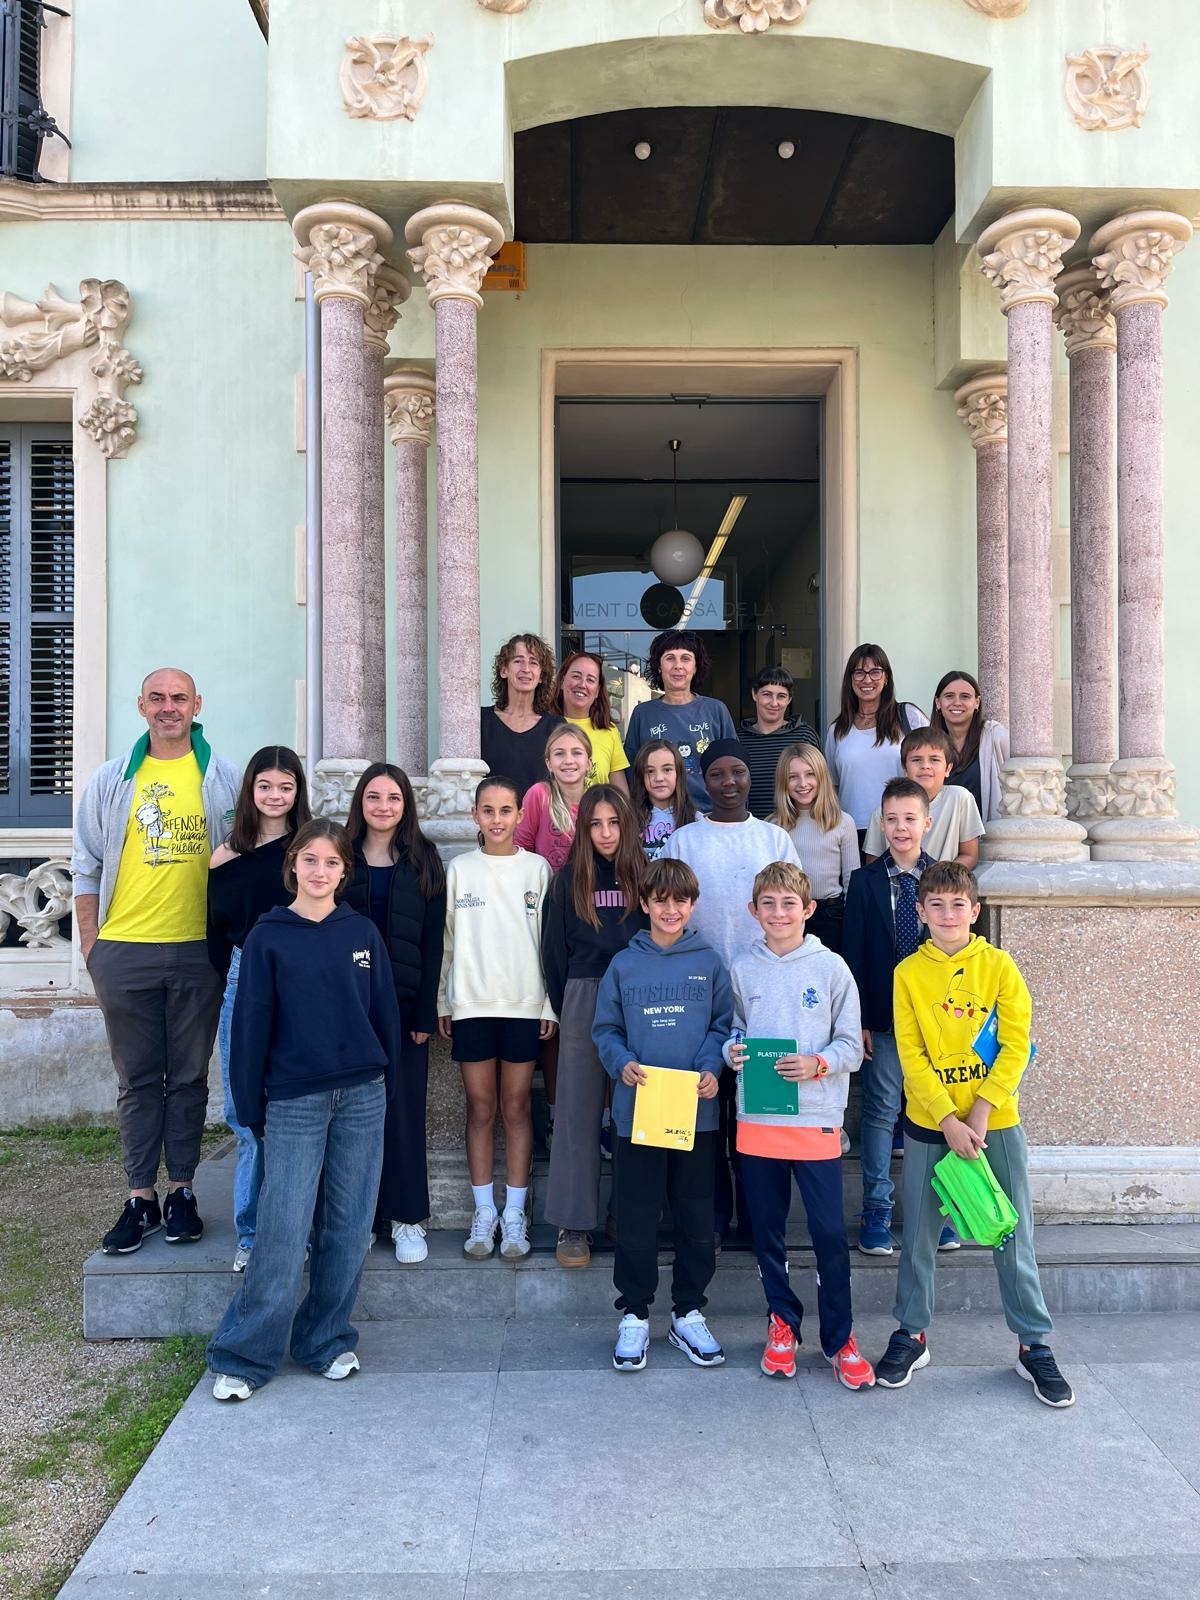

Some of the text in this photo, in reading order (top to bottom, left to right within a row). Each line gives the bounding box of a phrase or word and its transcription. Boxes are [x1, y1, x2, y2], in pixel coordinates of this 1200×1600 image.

[690, 722, 710, 732] LOVE
[644, 1005, 685, 1015] NEW YORK
